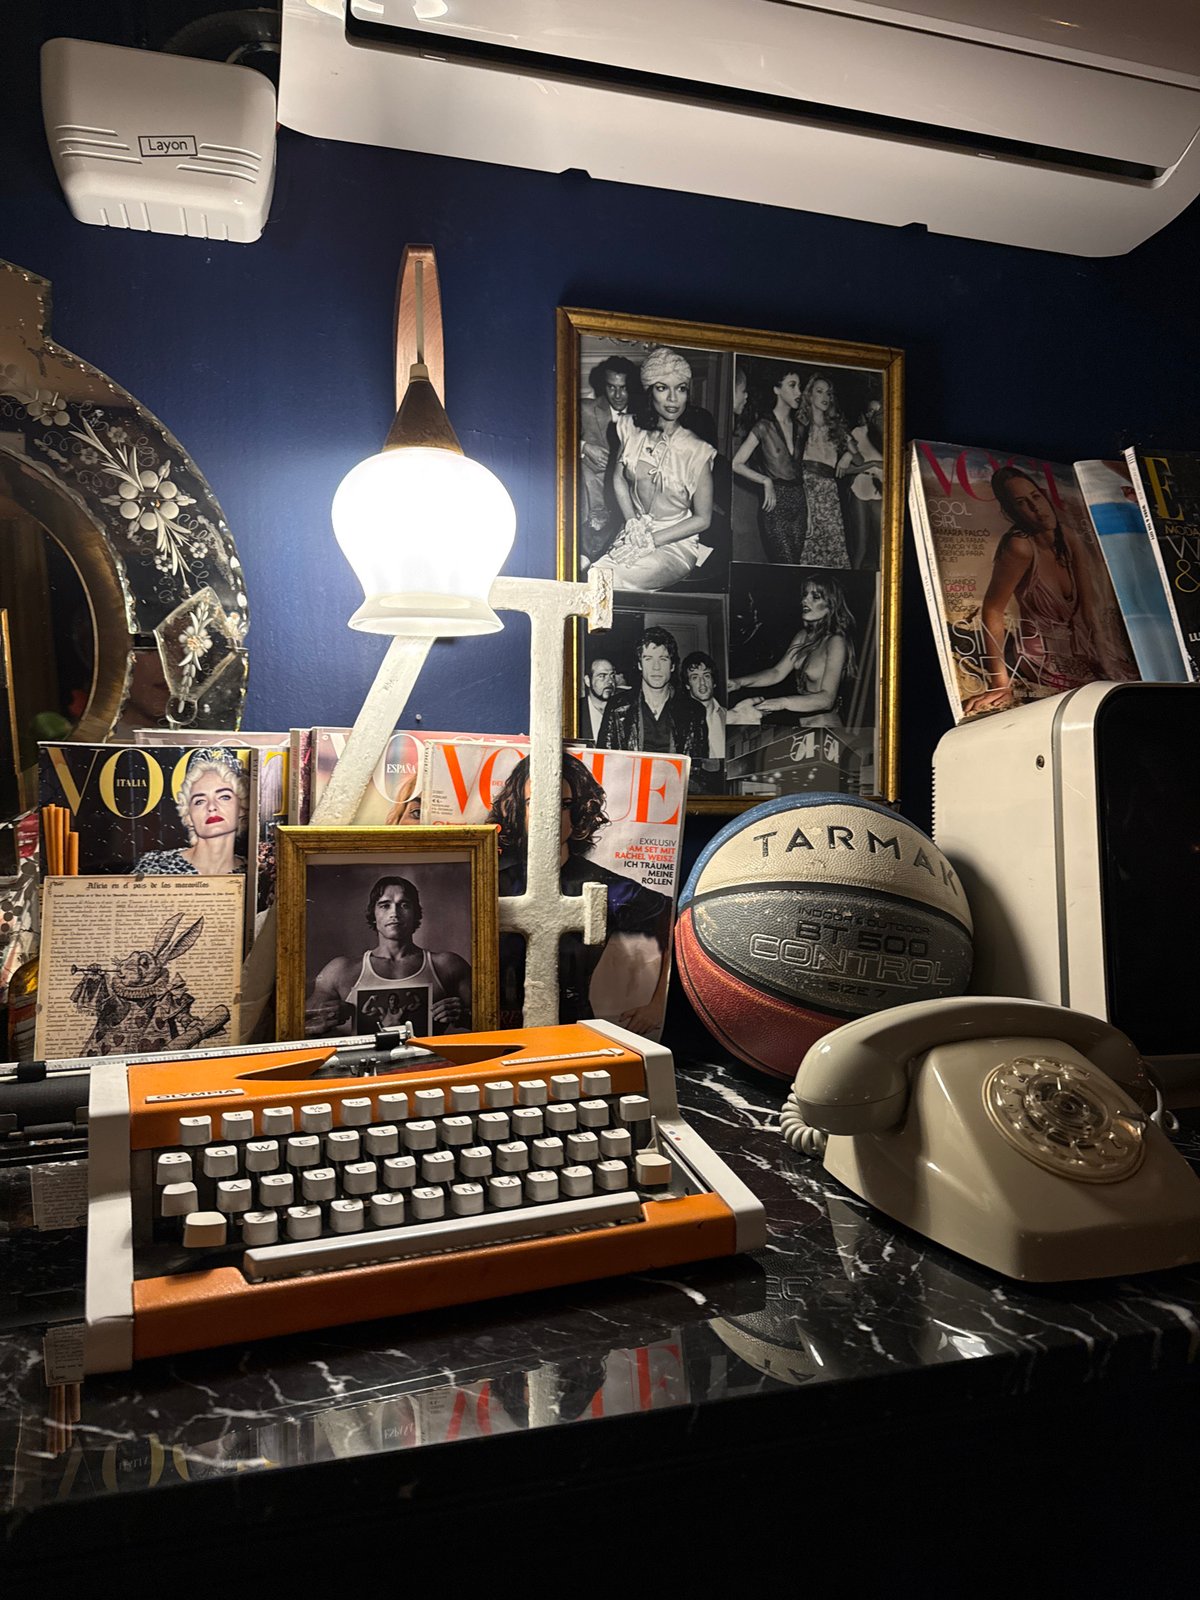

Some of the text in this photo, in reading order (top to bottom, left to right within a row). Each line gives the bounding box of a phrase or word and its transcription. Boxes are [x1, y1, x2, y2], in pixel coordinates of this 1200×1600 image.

[148, 138, 188, 154] Layon
[930, 513, 962, 529] GIRL
[959, 656, 1046, 692] SEXY
[790, 732, 820, 762] 54
[823, 734, 840, 764] 54
[386, 763, 416, 774] ESPAÑA
[117, 778, 147, 788] ITALIA
[640, 838, 677, 846] EXKLUSIV
[615, 852, 645, 860] RACHEL
[753, 825, 959, 896] TARMAK
[640, 861, 675, 870] TRÄUME
[642, 877, 673, 885] ROLLEN
[648, 870, 674, 878] MEINE
[86, 882, 108, 890] Alicia
[175, 881, 209, 889] maravillas
[799, 908, 852, 921] INDOOR
[866, 918, 930, 935] OUTDOOR
[796, 920, 928, 957] BT 500
[750, 933, 952, 985] CONTROL
[828, 982, 888, 998] SIZE 7
[156, 1090, 235, 1099] OLYMPIA
